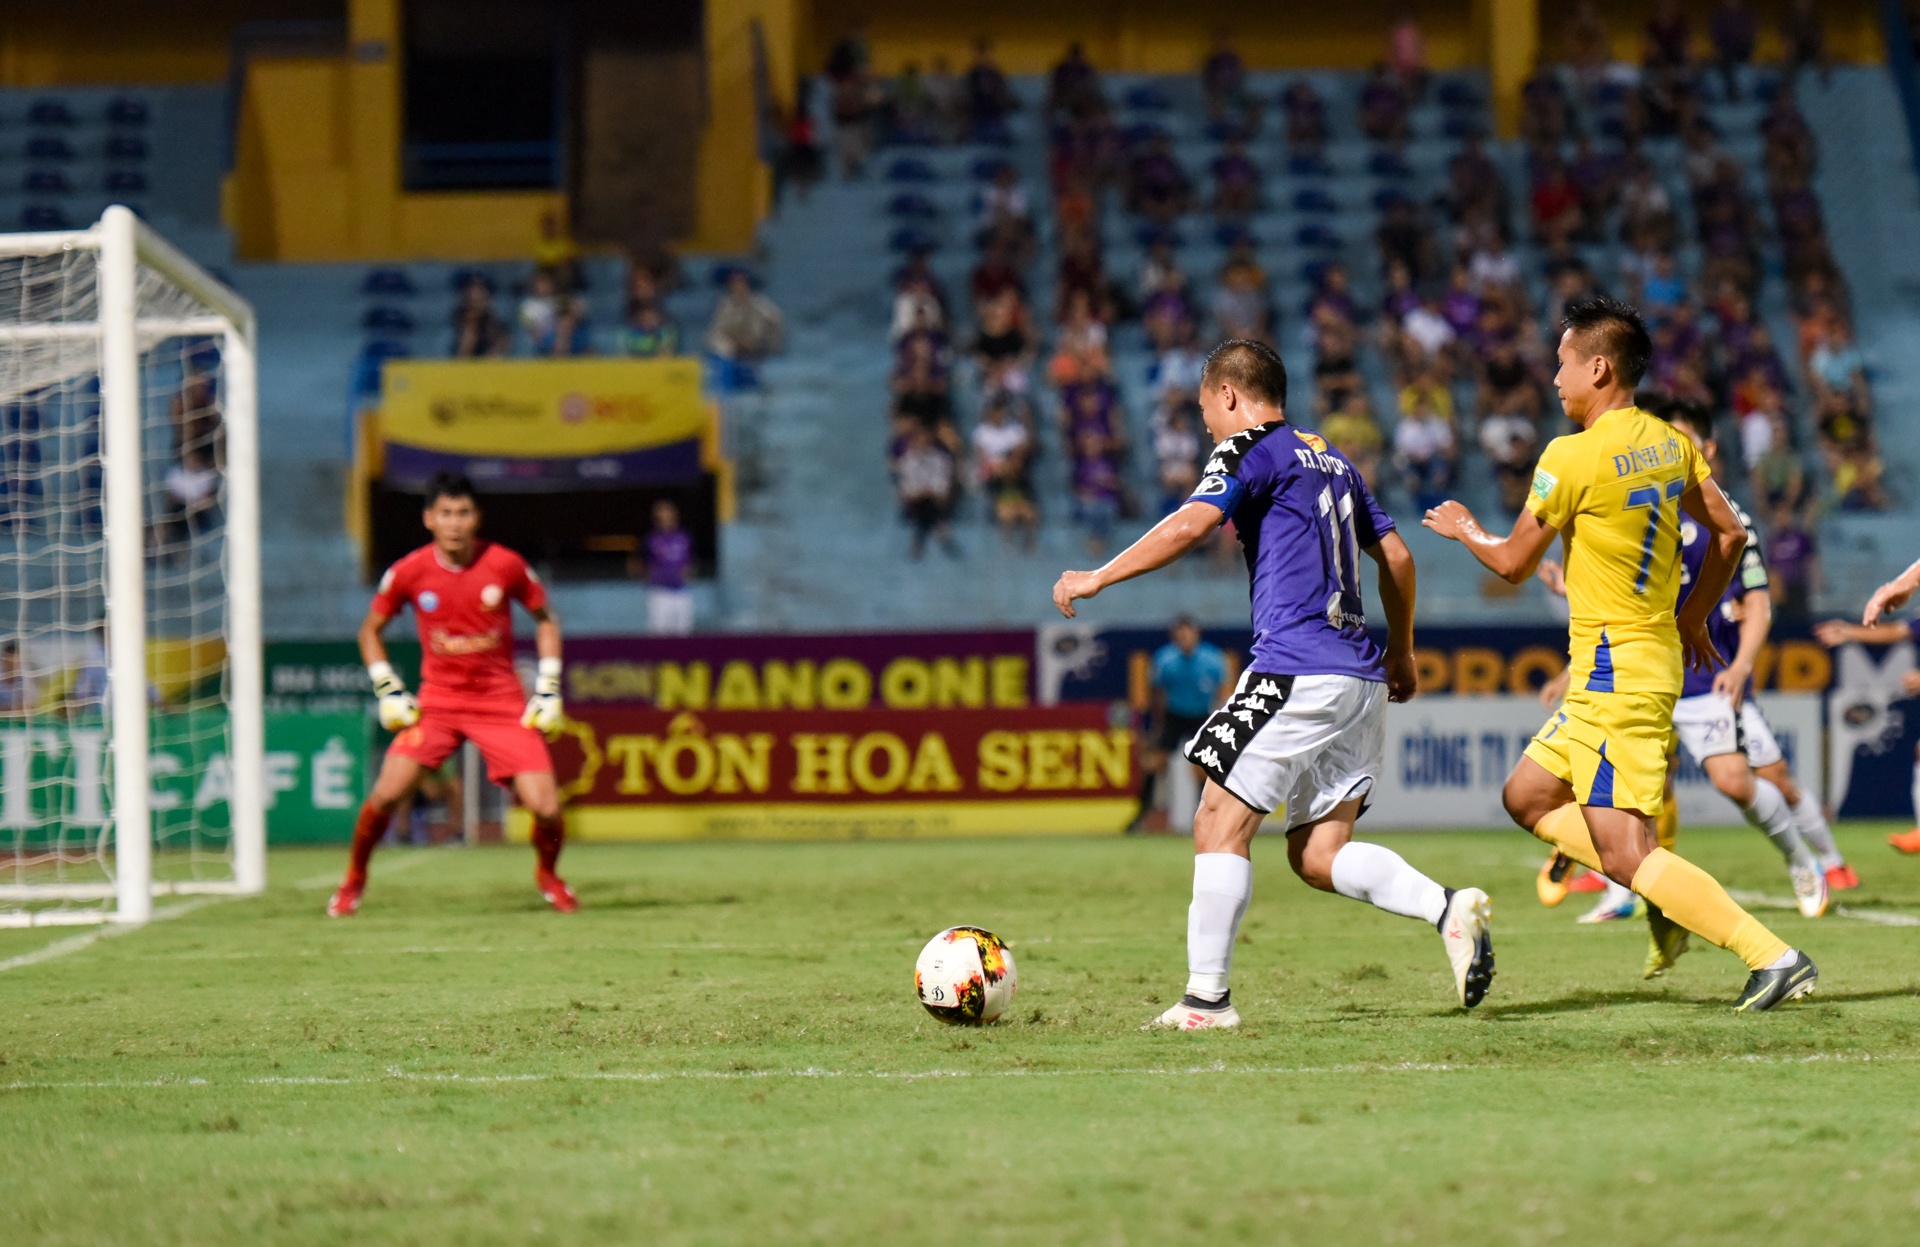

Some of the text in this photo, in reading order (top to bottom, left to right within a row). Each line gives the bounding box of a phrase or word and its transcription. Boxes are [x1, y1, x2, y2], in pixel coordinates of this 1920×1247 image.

[1612, 444, 1661, 478] ĐÌNH
[1317, 484, 1361, 599] 11
[1622, 475, 1685, 594] 77
[656, 659, 872, 711] NANO
[880, 655, 1028, 708] ONE
[606, 712, 1132, 795] TÔN HOA SEN
[1703, 718, 1730, 743] 29
